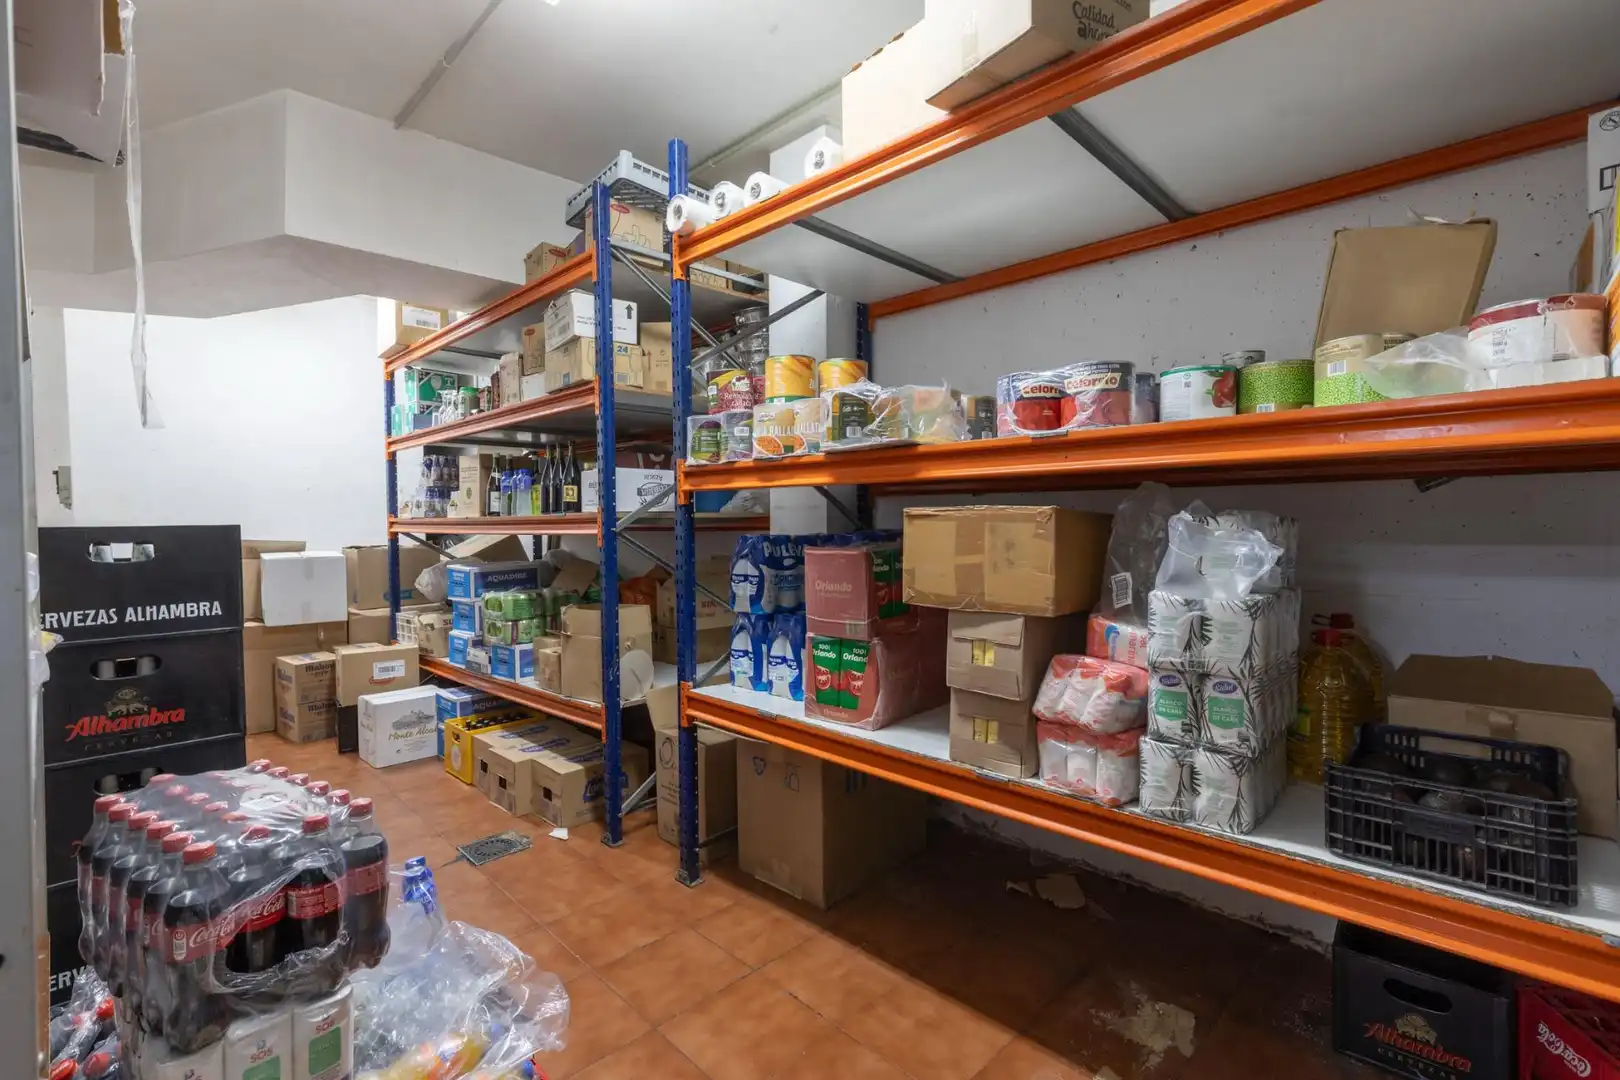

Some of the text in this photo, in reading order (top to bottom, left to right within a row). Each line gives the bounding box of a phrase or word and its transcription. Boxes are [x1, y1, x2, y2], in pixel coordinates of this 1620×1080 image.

[1072, 0, 1115, 28] Calidad
[616, 344, 629, 353] 24
[763, 541, 803, 557] PULEV
[815, 579, 852, 593] Orlando
[40, 601, 222, 630] ERVEZAS ALHAMBRA
[65, 706, 185, 742] Alhambra
[389, 731, 413, 741] Monte
[250, 1047, 273, 1063] SOS
[1363, 1022, 1472, 1073] Alhambra
[1536, 1020, 1591, 1078] Coca-Cola
